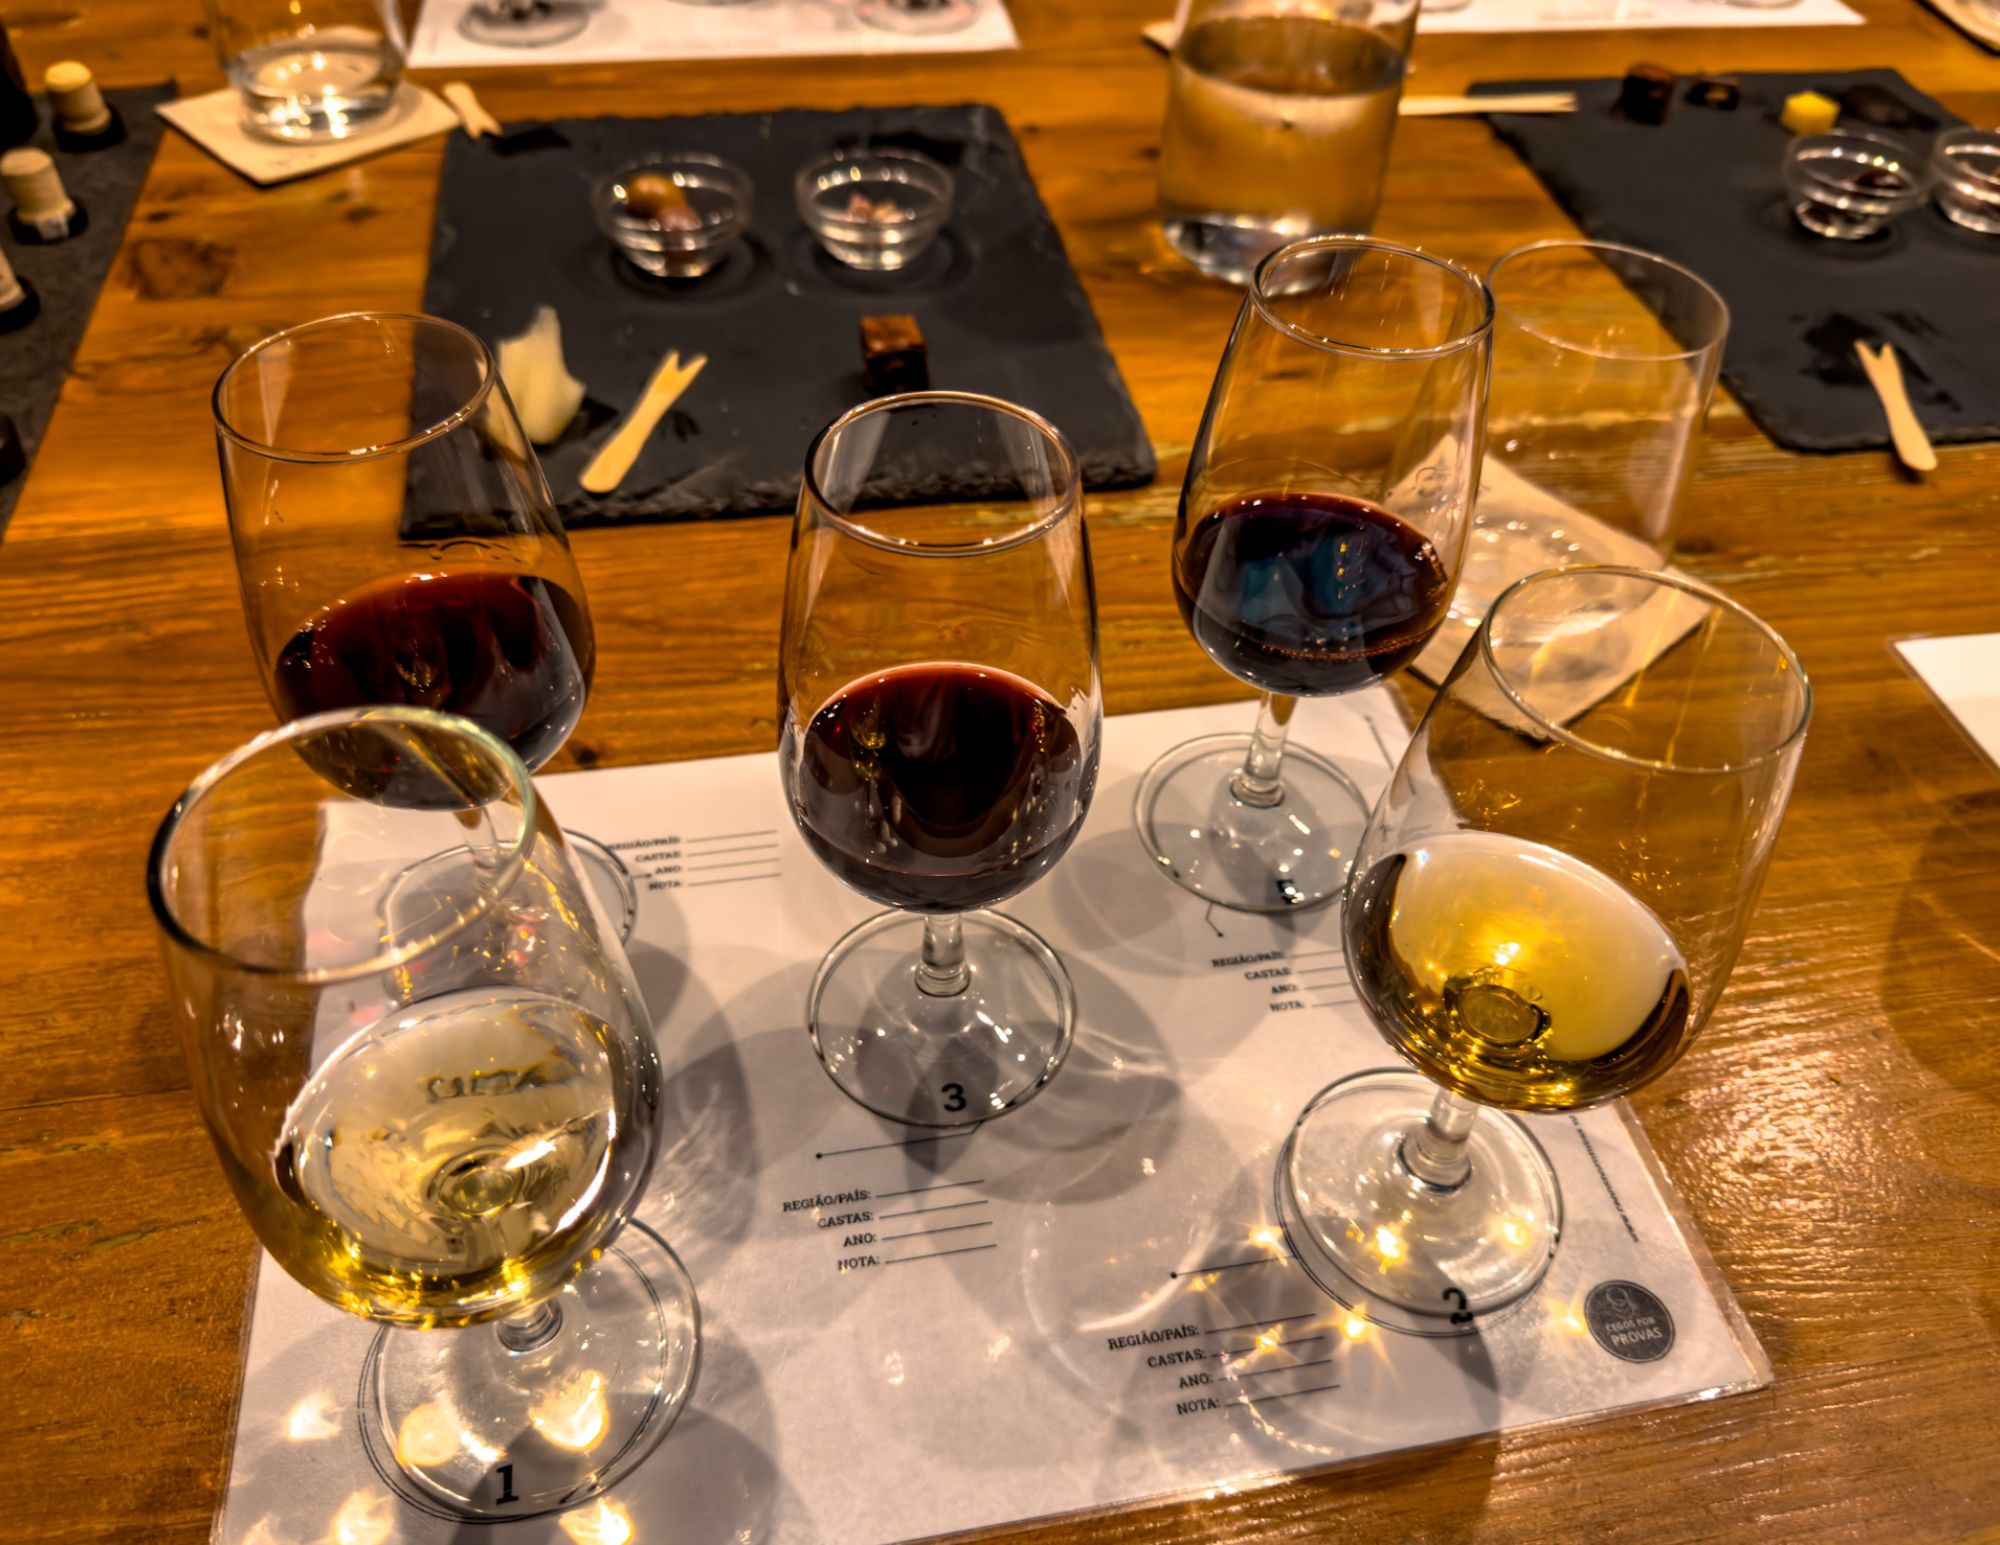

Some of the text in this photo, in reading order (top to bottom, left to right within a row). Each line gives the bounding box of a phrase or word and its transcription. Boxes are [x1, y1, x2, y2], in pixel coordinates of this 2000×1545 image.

[941, 1083, 967, 1111] 3
[783, 1189, 870, 1212] REGIÃO/PAÍS:
[817, 1211, 874, 1228] CASTAS:
[843, 1232, 877, 1247] ANO:
[838, 1255, 880, 1271] NOTA:
[1442, 1287, 1473, 1324] 2
[1107, 1324, 1199, 1350] REGIÃO/PAÍS:
[1610, 1327, 1662, 1346] PROVAS
[1147, 1348, 1206, 1368] CASTAS:
[1179, 1372, 1213, 1388] ANO:
[1176, 1398, 1220, 1415] NOTA:
[496, 1464, 518, 1505] 1
